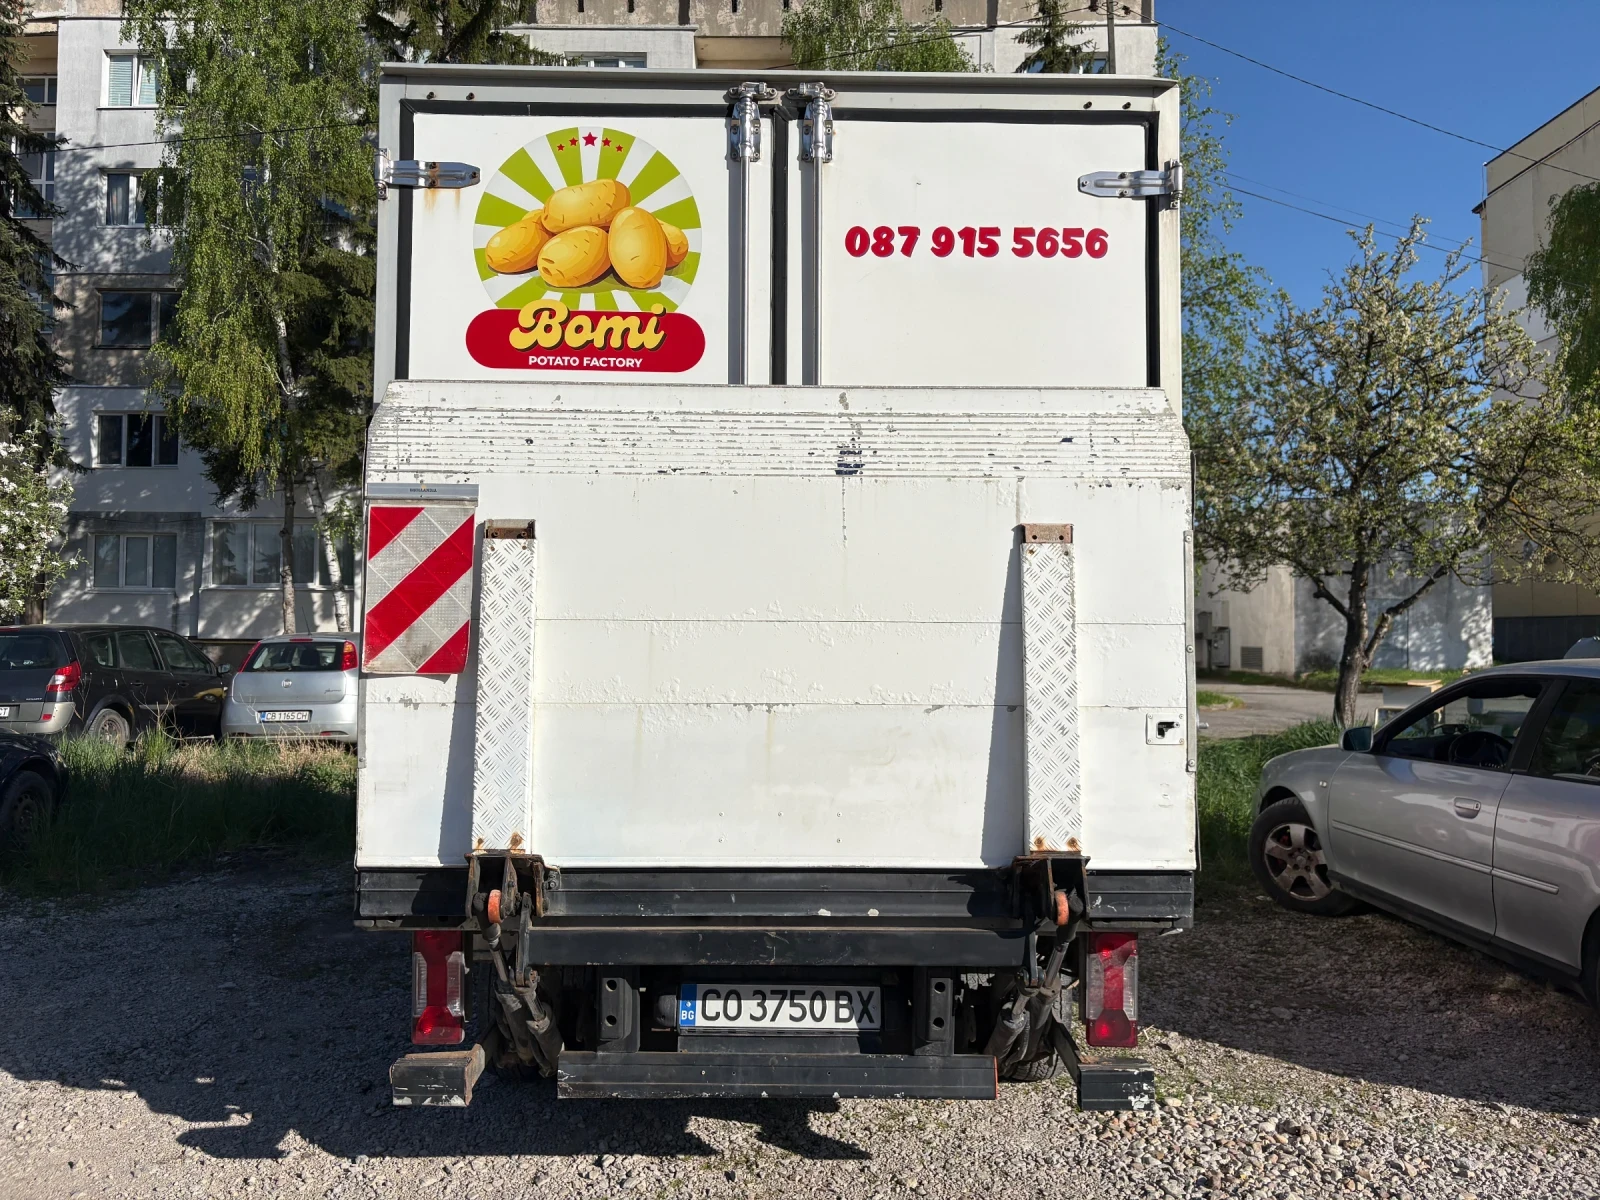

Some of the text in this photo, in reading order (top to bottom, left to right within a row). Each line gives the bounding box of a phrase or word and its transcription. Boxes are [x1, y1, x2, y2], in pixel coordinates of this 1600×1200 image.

[845, 225, 1109, 259] 087 915 5656
[508, 298, 667, 352] Bomi
[528, 355, 643, 368] POTATO FACTORY
[265, 712, 308, 720] CB 1165 CH
[681, 1010, 695, 1020] BG
[701, 989, 875, 1023] CO 3750 BX
